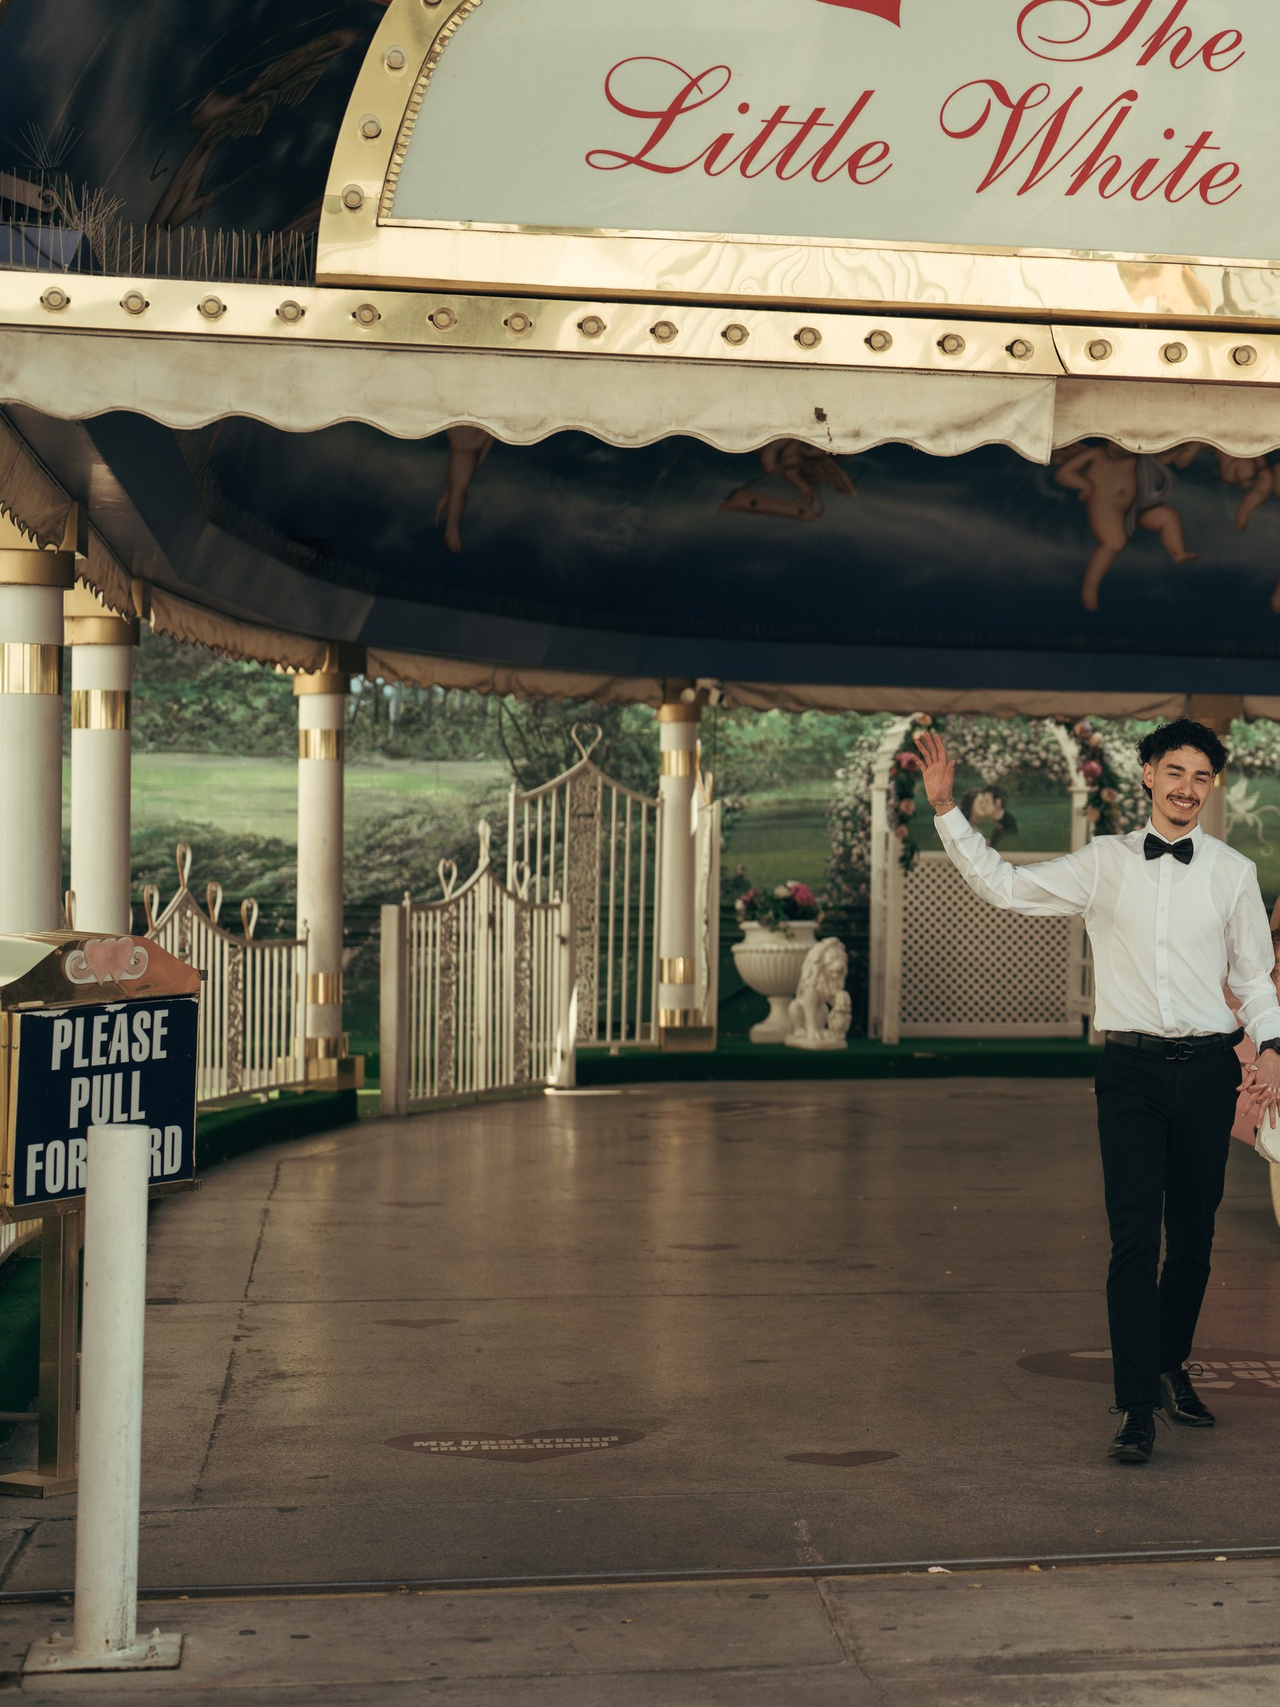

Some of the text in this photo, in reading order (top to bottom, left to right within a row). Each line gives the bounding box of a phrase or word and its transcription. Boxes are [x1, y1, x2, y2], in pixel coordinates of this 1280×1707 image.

[1015, 0, 1247, 73] The
[584, 55, 893, 187] Little
[939, 78, 1243, 206] White
[51, 1009, 169, 1071] PLEASE
[69, 1070, 146, 1129] PULL
[26, 1125, 183, 1197] FORRD
[413, 1440, 455, 1448] My
